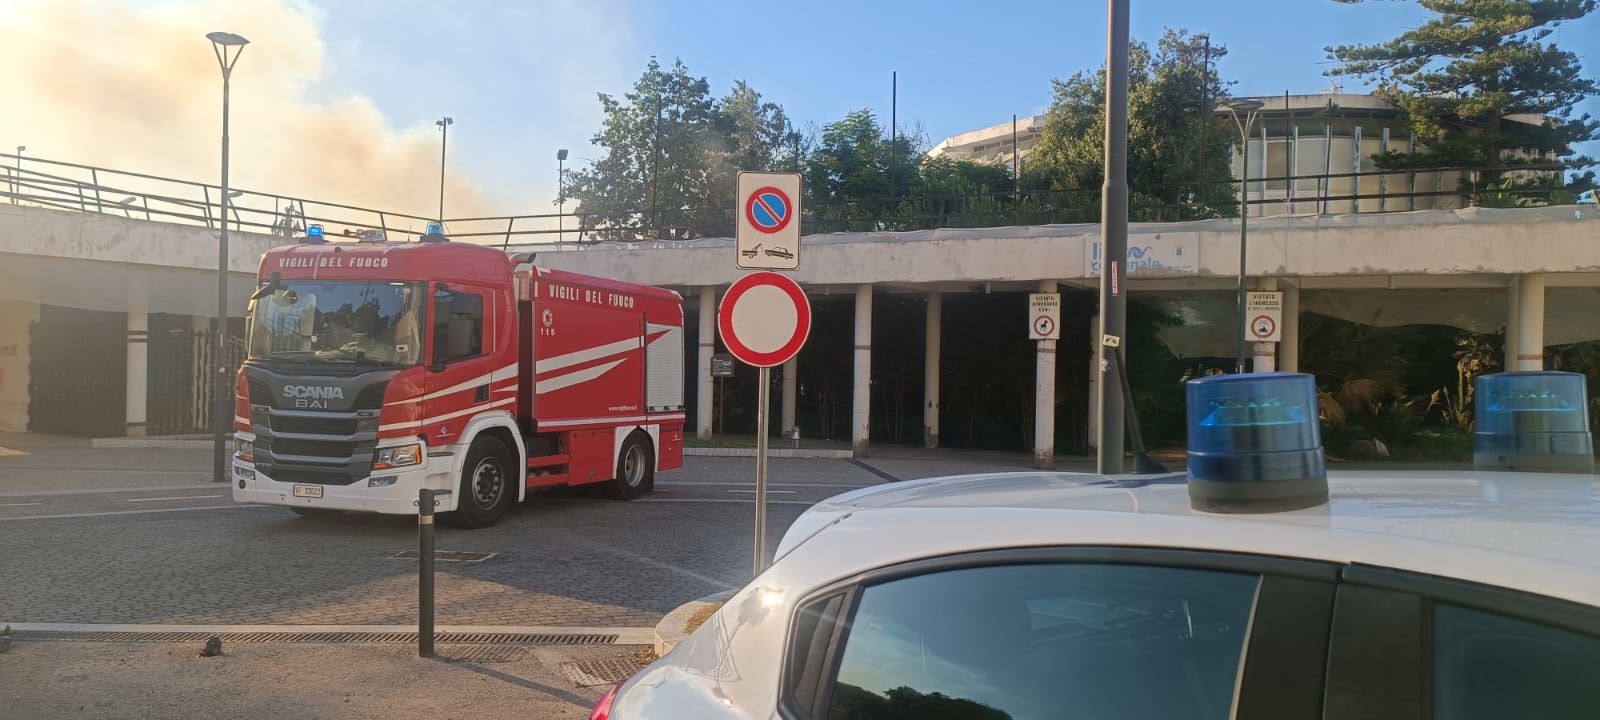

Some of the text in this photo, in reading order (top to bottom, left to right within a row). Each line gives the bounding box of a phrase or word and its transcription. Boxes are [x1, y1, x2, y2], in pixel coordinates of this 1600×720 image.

[279, 257, 388, 268] VIGILI DEL FUOCO
[549, 284, 634, 309] VIGILI DEL FUOCO
[540, 327, 555, 336] 115
[283, 384, 344, 400] SCANIA
[295, 399, 327, 409] BAI
